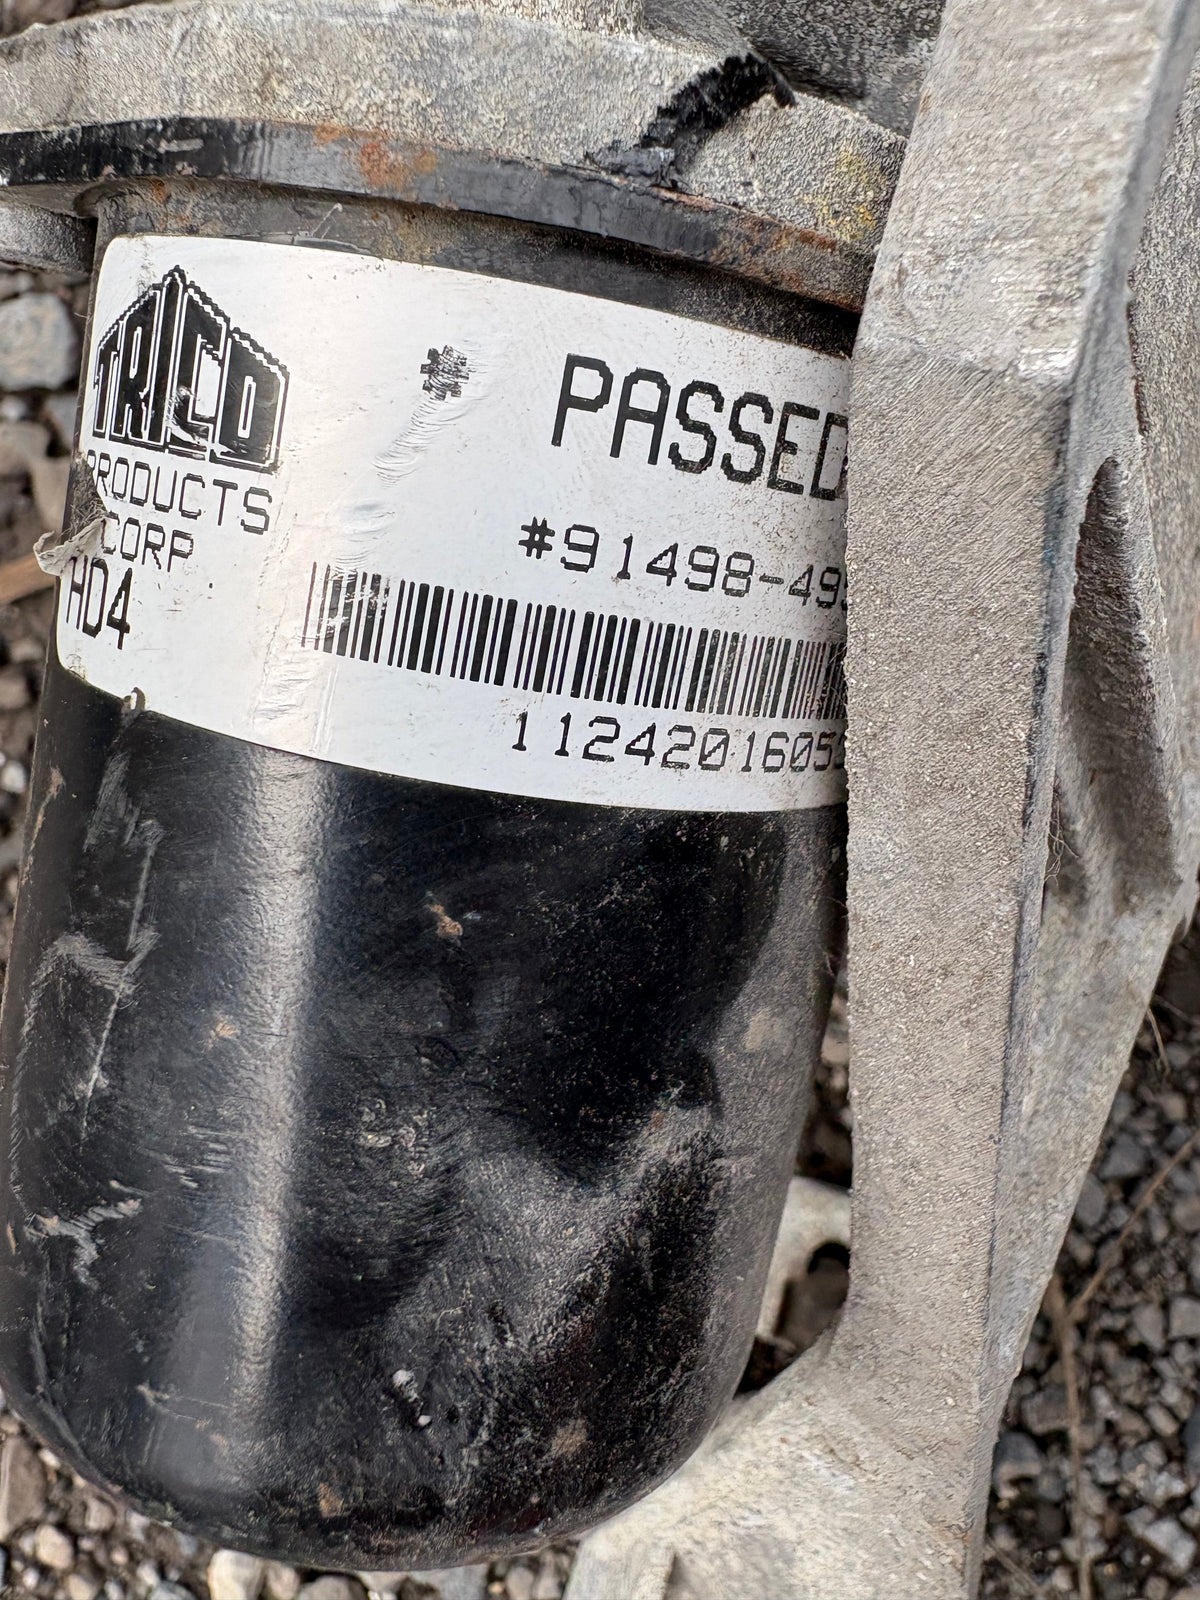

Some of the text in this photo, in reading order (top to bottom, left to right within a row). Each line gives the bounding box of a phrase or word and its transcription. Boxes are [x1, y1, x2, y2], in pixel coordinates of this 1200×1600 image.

[93, 264, 290, 475] TRICO
[551, 353, 848, 501] PASSED
[87, 449, 272, 535] PRODUCTS
[101, 511, 194, 573] CORP
[518, 517, 847, 610] #91498-49
[66, 555, 133, 650] HD4
